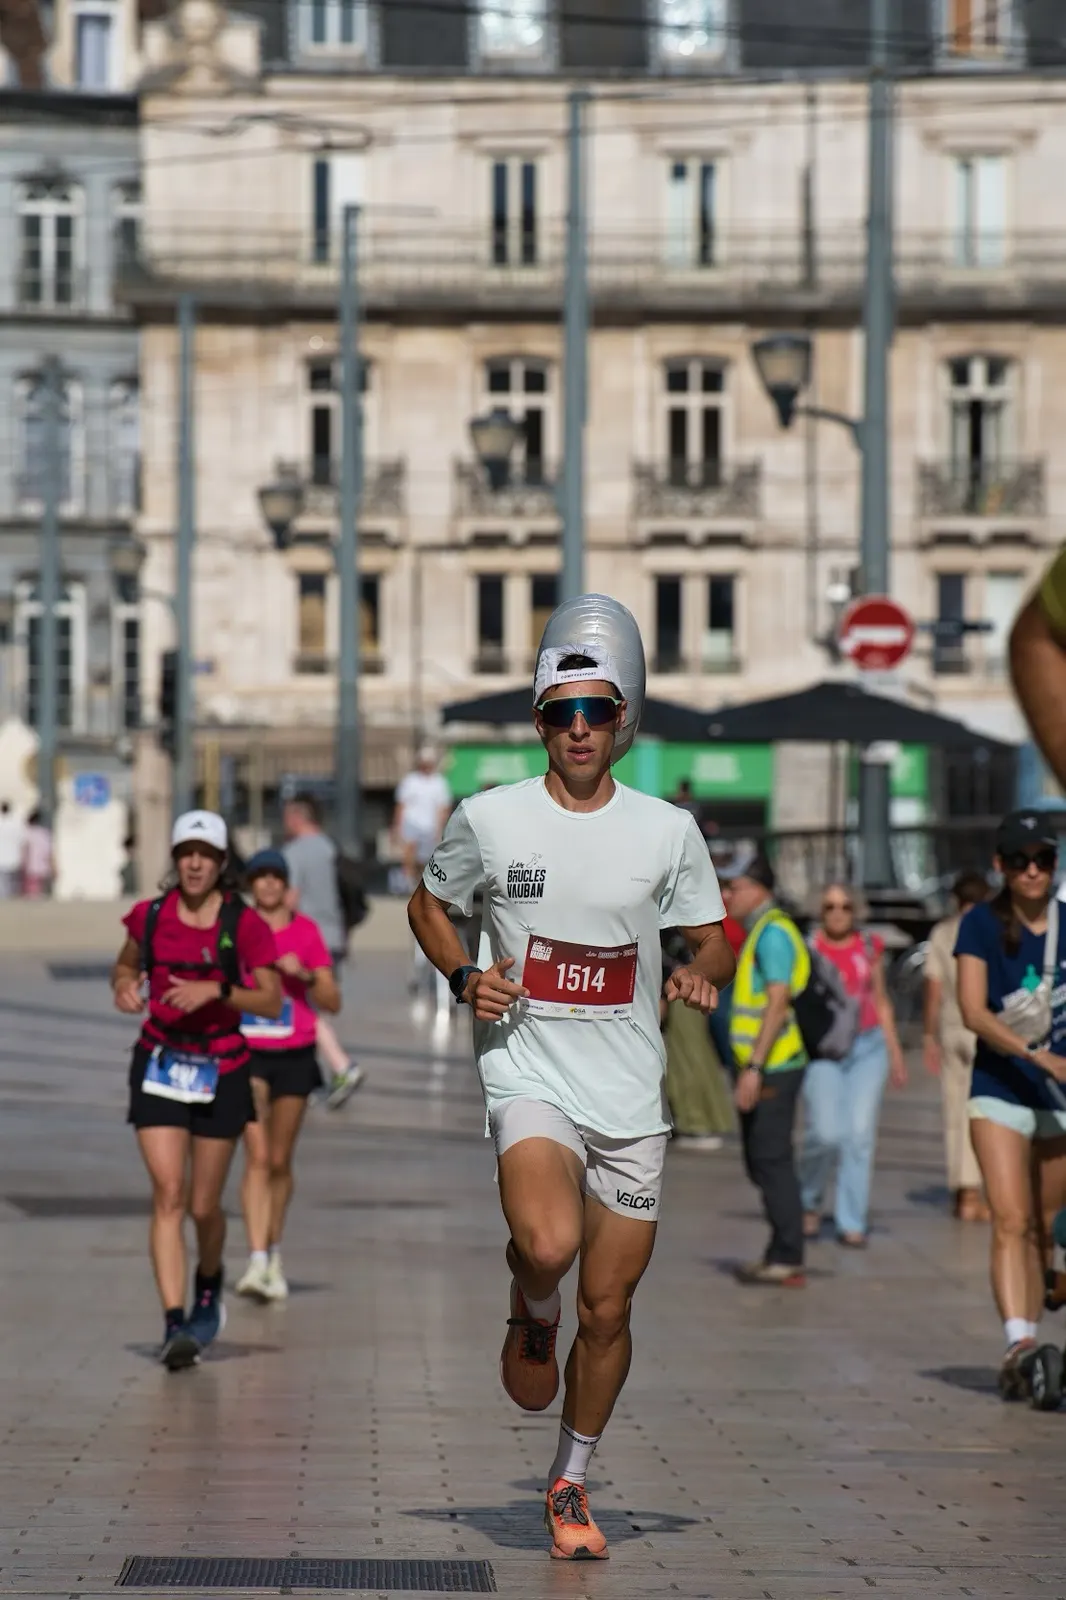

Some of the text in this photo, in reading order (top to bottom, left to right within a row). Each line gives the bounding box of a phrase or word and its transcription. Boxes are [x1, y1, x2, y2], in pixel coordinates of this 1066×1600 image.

[508, 859, 524, 869] Les
[507, 869, 546, 882] BOUCLES
[507, 883, 544, 898] VAUBAN
[557, 963, 605, 992] 1514
[617, 1189, 656, 1210] VELCAP
